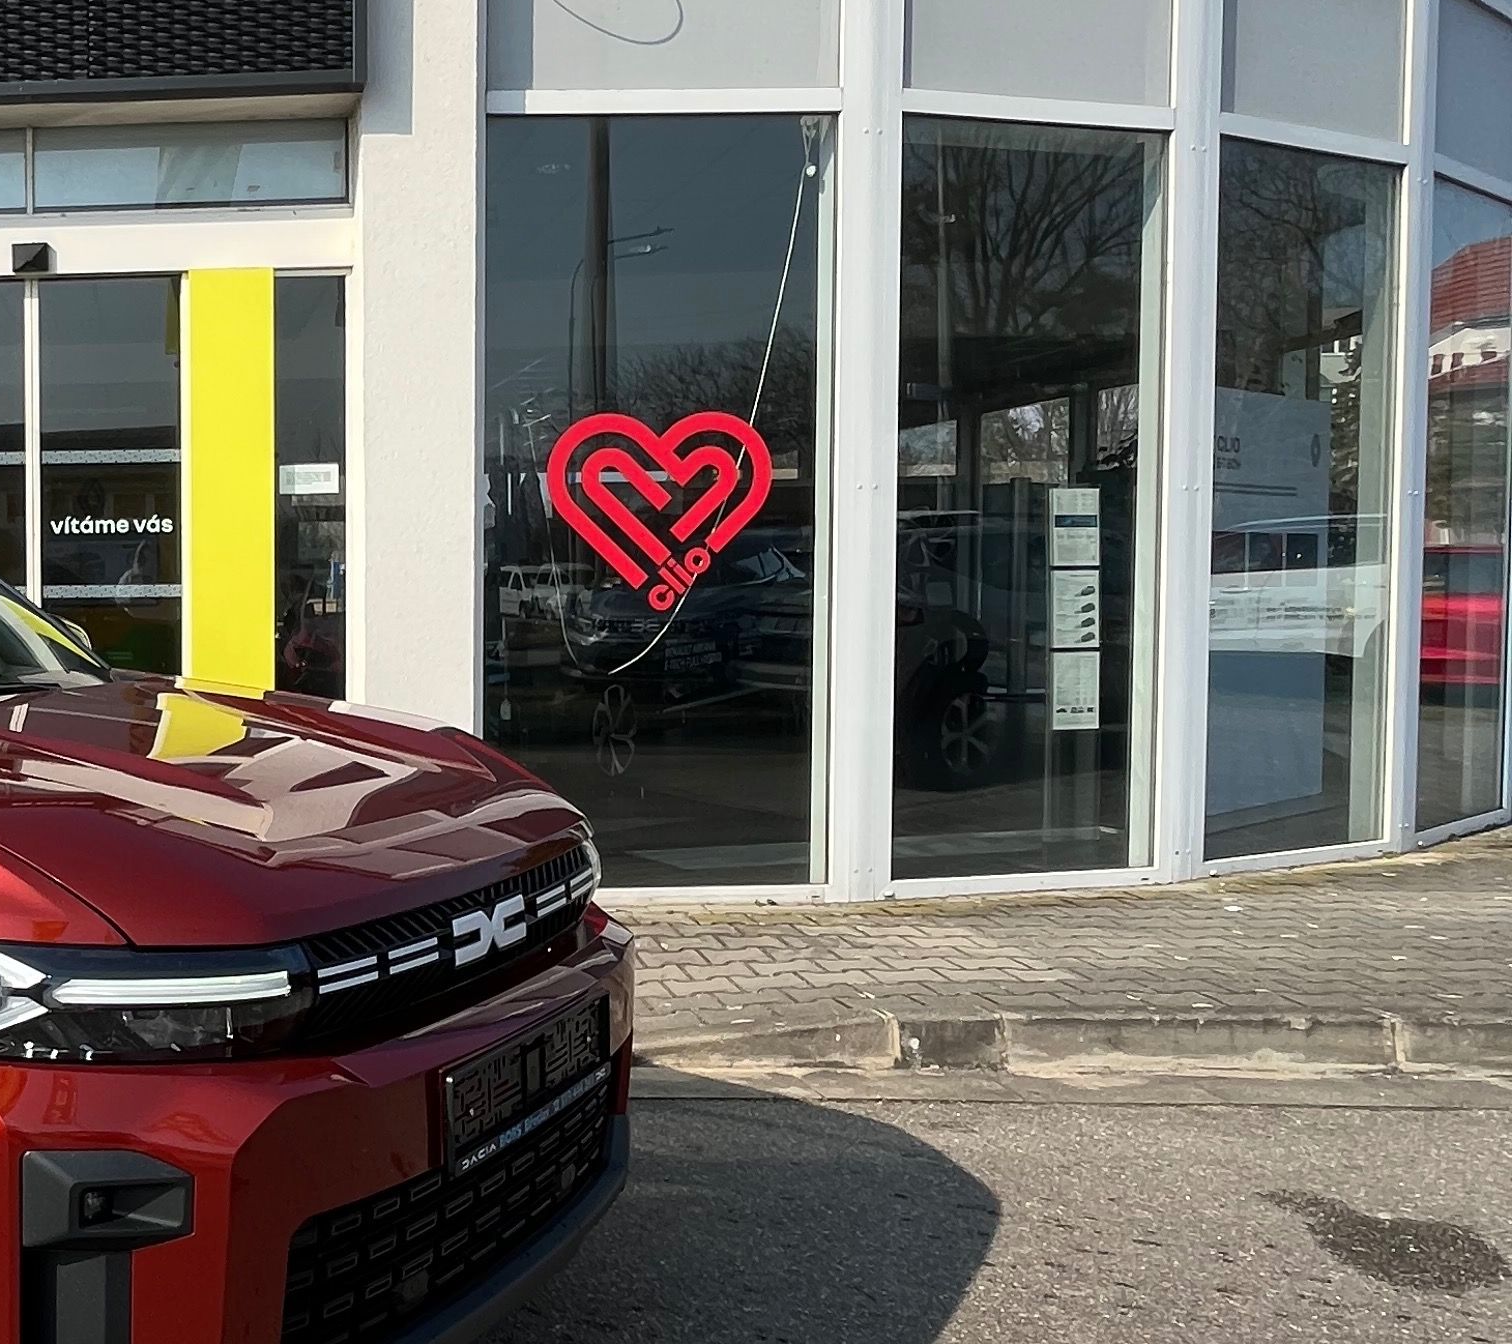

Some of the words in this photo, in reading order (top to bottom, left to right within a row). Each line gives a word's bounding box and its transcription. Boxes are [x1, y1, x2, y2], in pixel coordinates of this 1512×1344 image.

[50, 515, 129, 534] vítáme
[133, 514, 174, 533] vás
[649, 547, 711, 611] clio
[462, 1143, 497, 1170] DACIA
